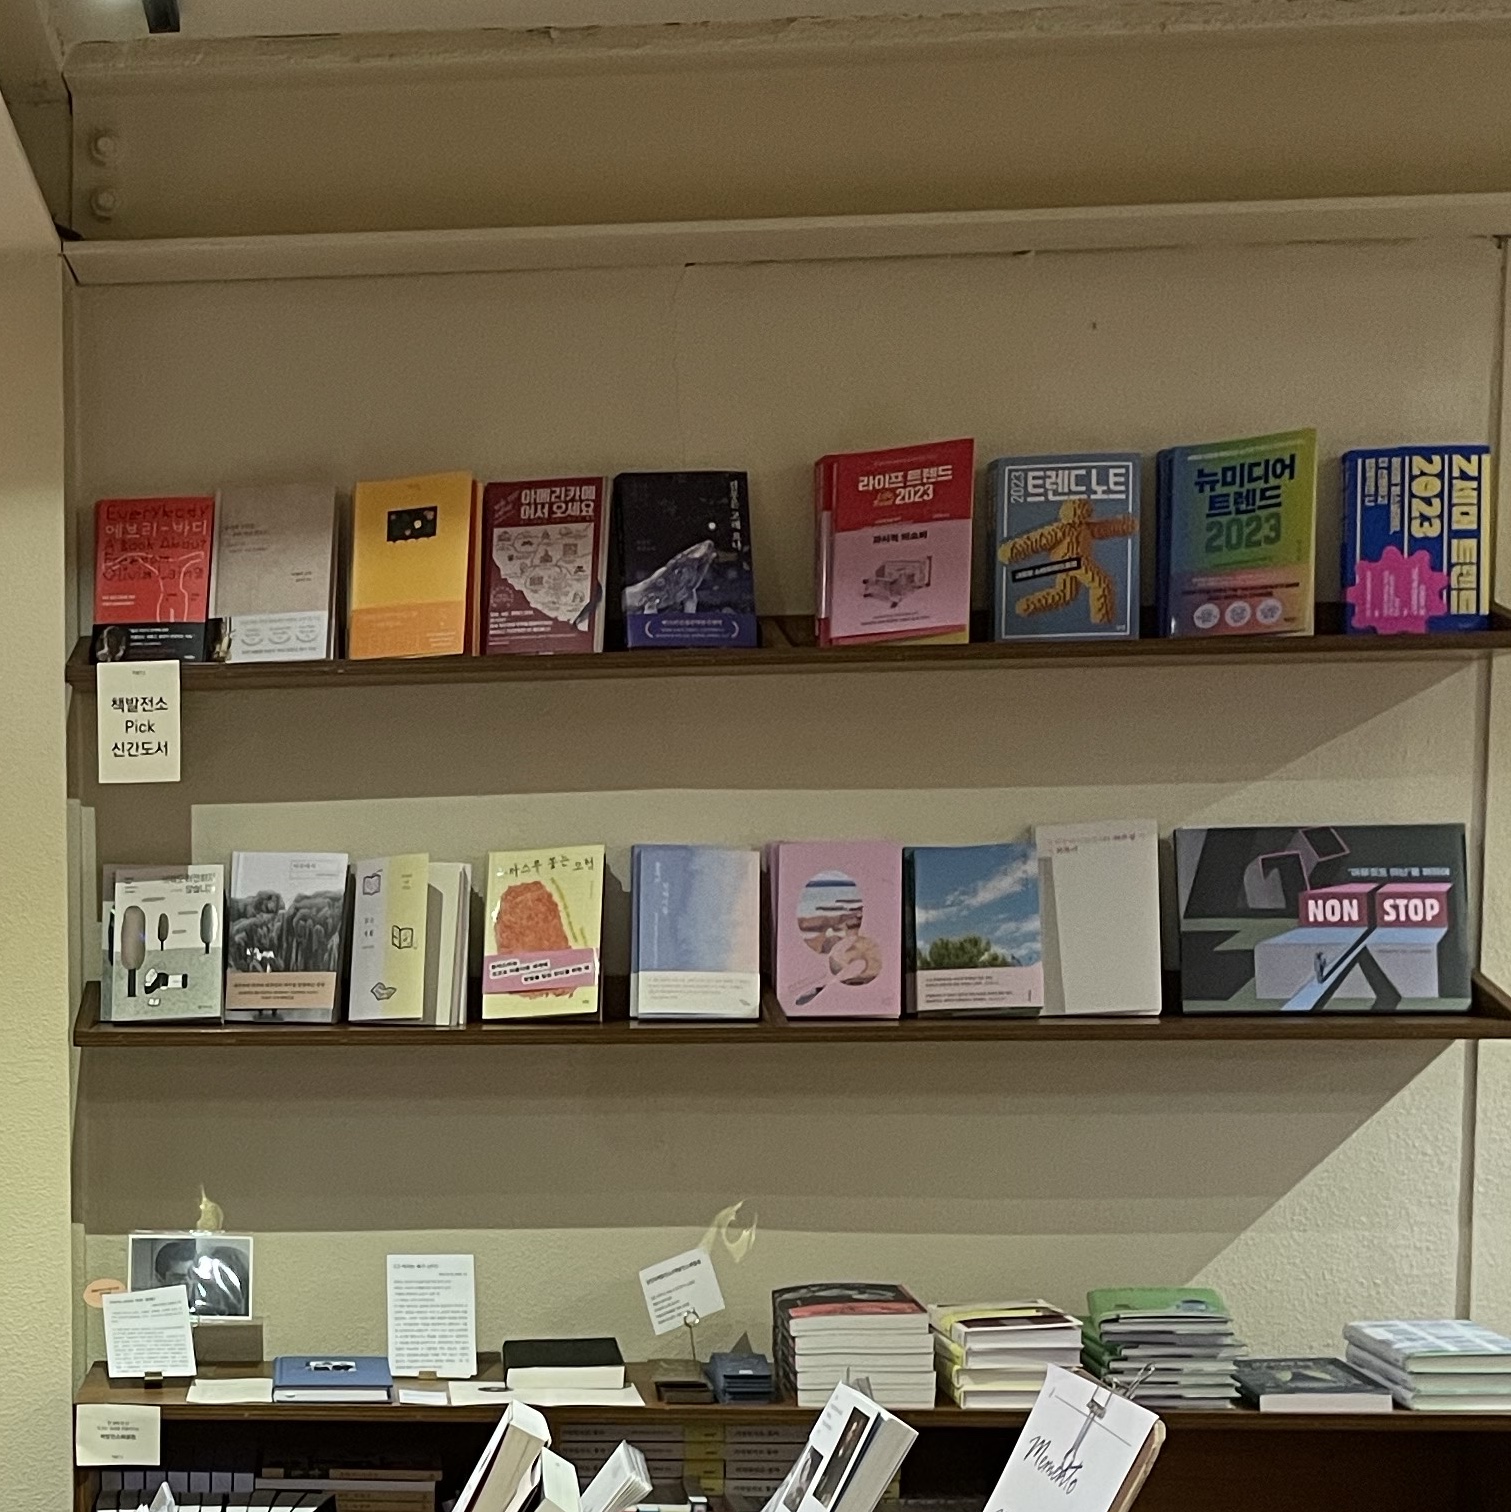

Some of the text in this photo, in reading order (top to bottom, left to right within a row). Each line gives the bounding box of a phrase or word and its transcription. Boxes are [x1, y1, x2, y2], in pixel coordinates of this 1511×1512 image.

[857, 464, 953, 492] 라이프 트렌드
[1010, 467, 1129, 504] 2023 트렌드 노트
[1194, 453, 1297, 494] 뉴미디어
[894, 484, 934, 506] 2023
[1205, 484, 1283, 527] 트렌드
[1410, 454, 1442, 539] 2023
[520, 501, 596, 520] 어서 오세요
[1205, 511, 1283, 562] 2023
[1450, 538, 1479, 615] 트렌드
[111, 696, 169, 713] 책발전소
[125, 719, 156, 734] Pick
[111, 740, 169, 758] 신간도서
[1307, 899, 1440, 922] NON STOP
